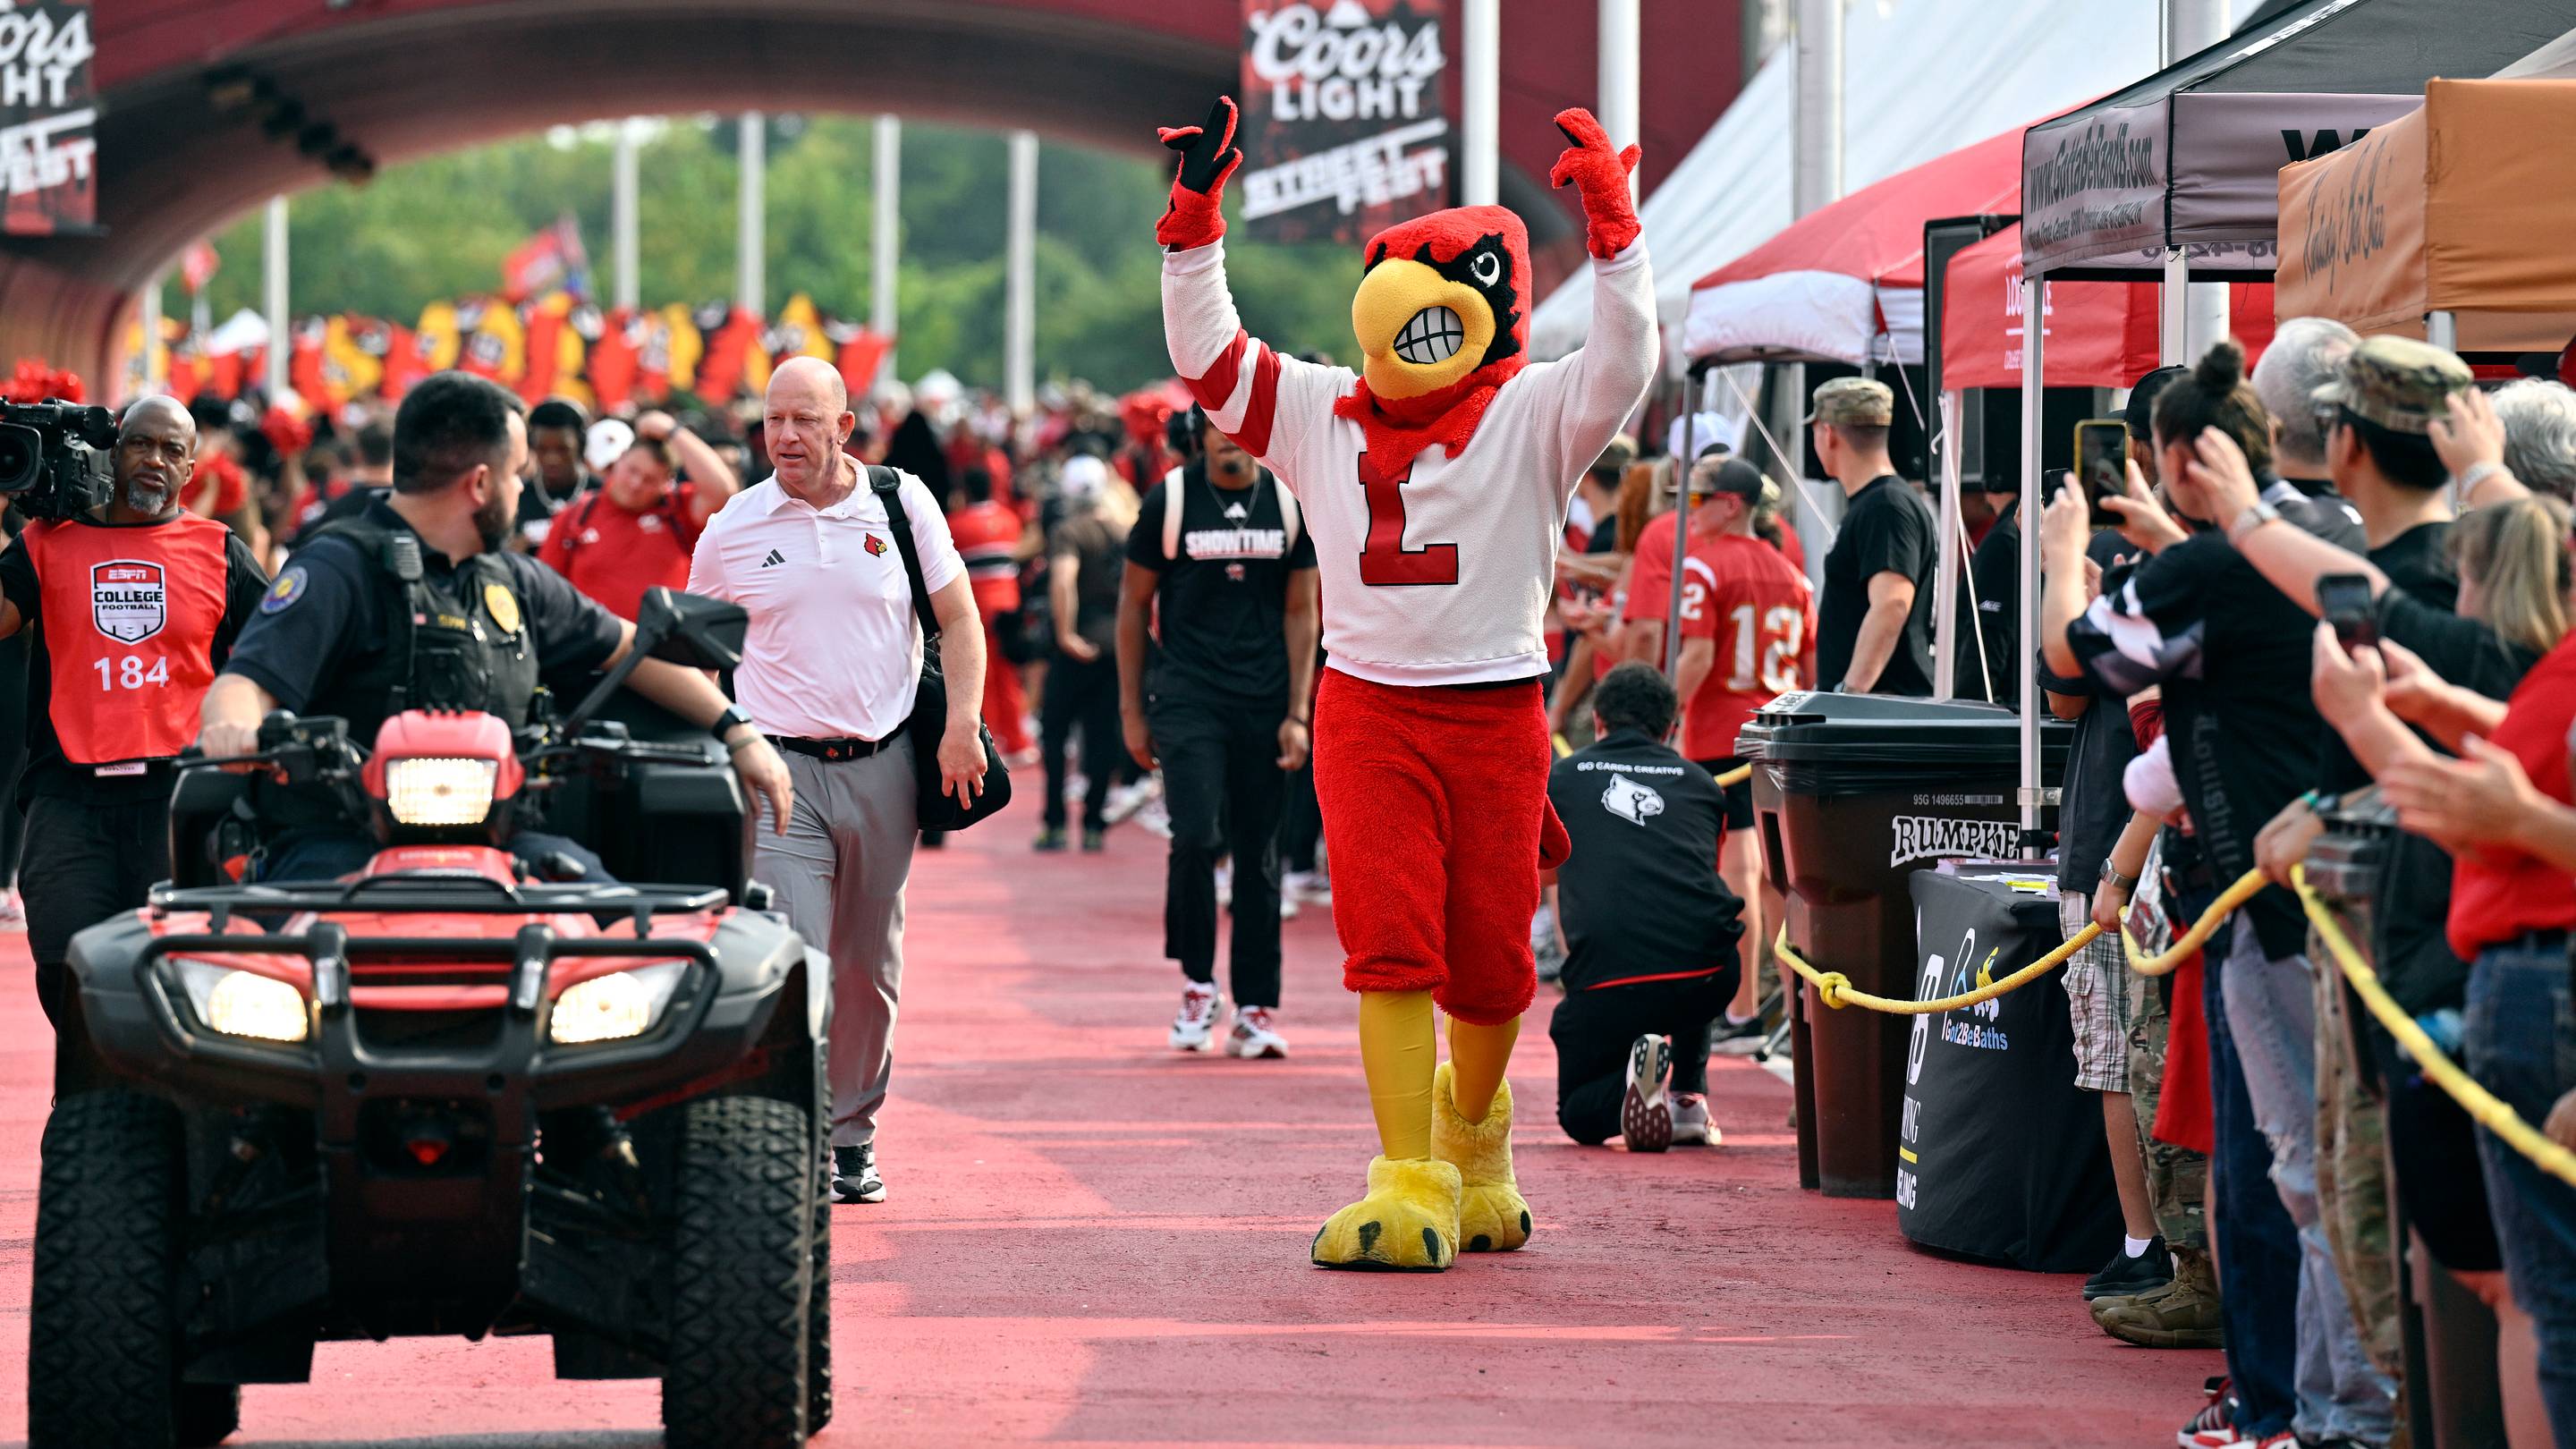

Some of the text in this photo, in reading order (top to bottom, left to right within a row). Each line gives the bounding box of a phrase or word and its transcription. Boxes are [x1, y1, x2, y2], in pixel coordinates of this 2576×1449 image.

[1249, 3, 1447, 81] Coors
[1273, 77, 1425, 120] LIGHT
[1241, 118, 1447, 221] STREET
[1336, 147, 1447, 215] FEST
[1358, 452, 1459, 586] L
[1185, 529, 1285, 555] SHOWTIME
[108, 567, 148, 581] ESPN
[94, 590, 164, 604] COLLEGE
[1726, 604, 1804, 696] 12
[94, 656, 170, 691] 184
[1577, 761, 1684, 776] GO CARDS CREATIVE
[1913, 793, 1964, 806] 95G 1496655
[1891, 815, 2021, 869] RUMPKE
